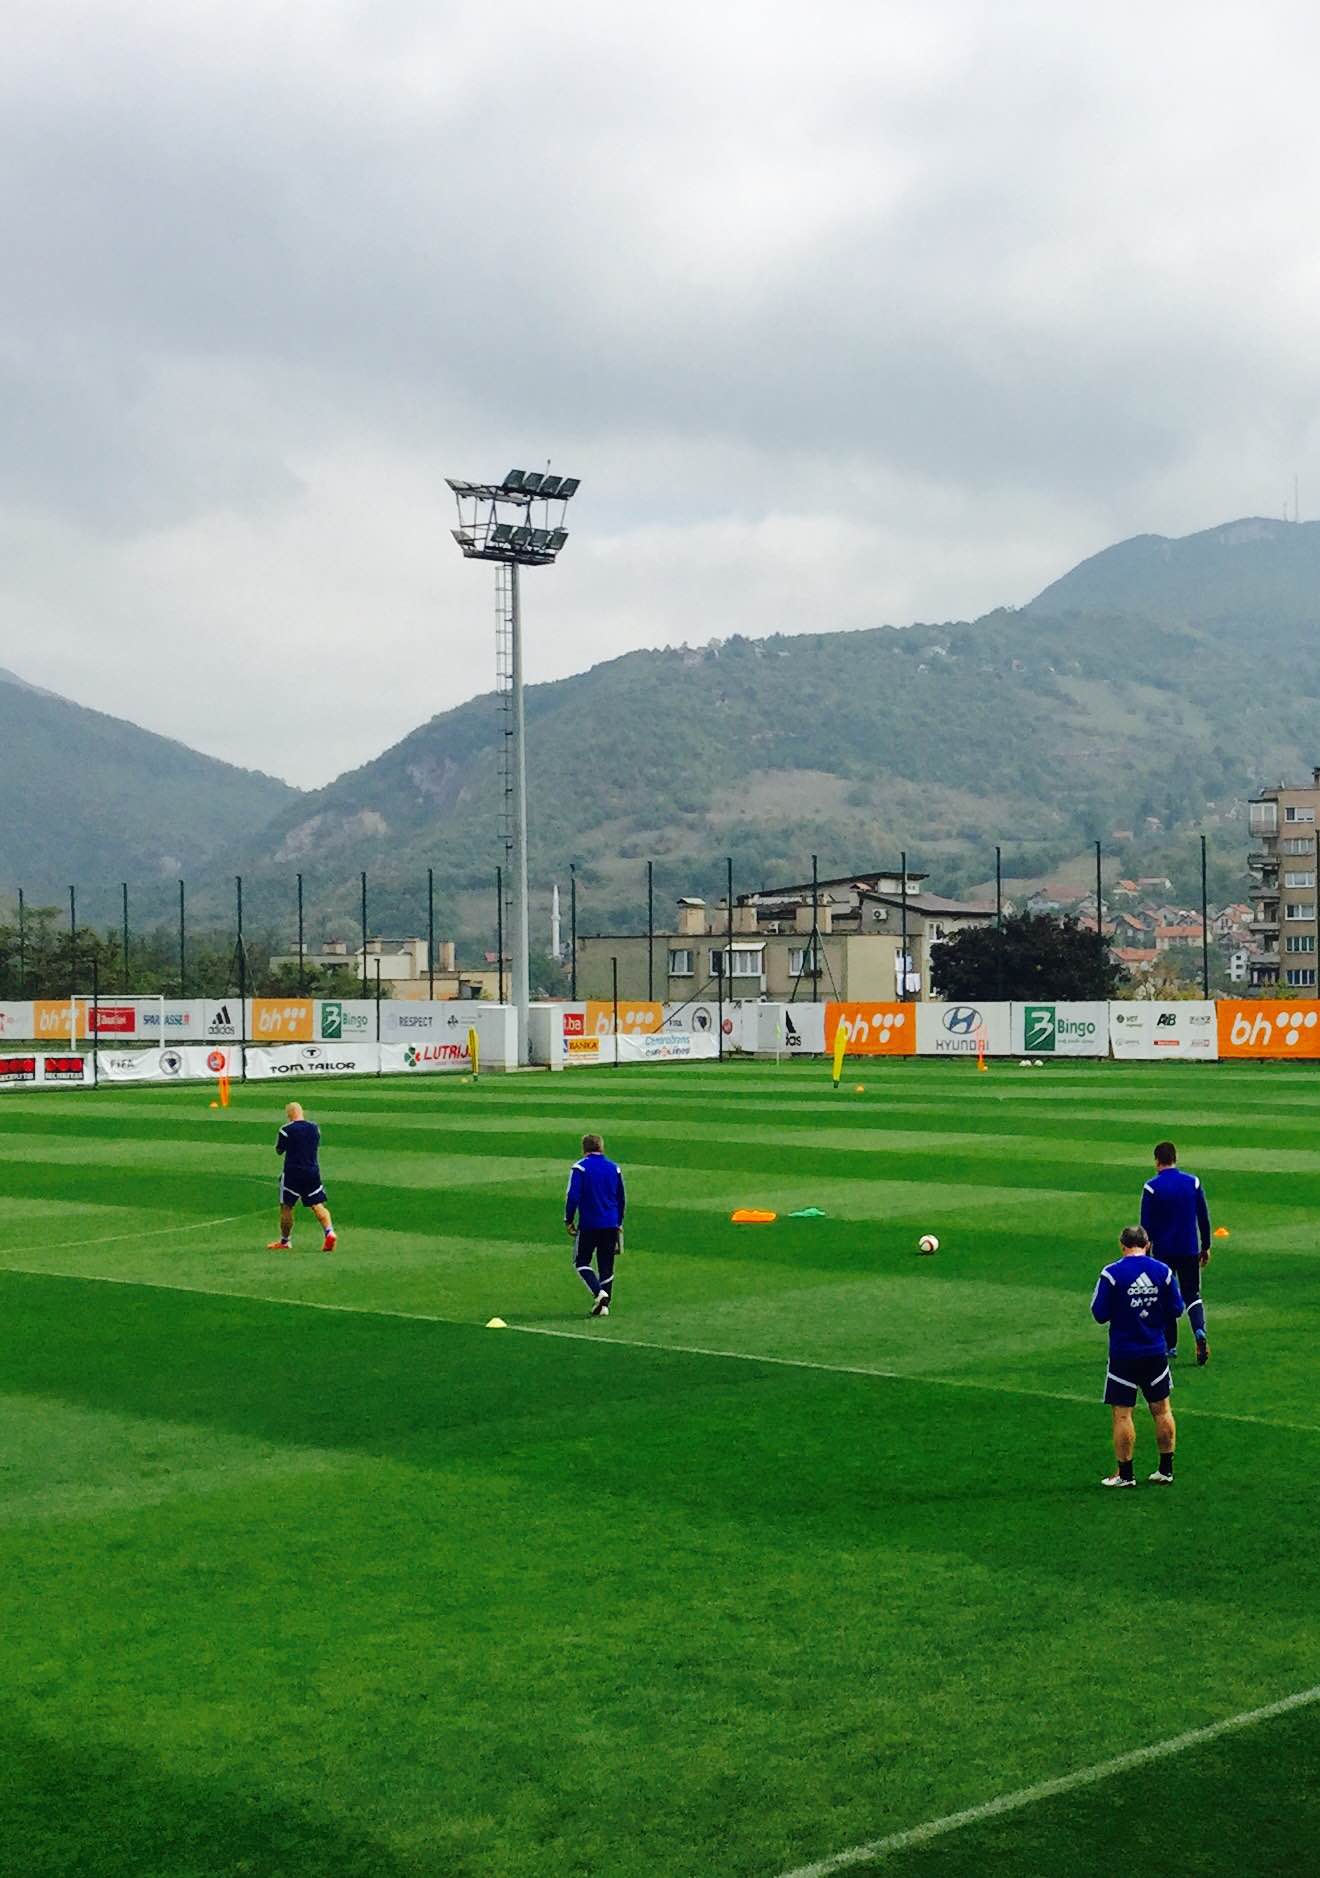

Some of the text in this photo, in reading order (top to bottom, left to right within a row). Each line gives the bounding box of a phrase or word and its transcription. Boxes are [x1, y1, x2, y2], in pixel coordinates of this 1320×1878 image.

[143, 1014, 183, 1025] SPARASSE
[258, 1007, 282, 1032] bh
[342, 1013, 368, 1029] Bingo
[399, 1016, 433, 1027] RESPECT
[207, 1025, 235, 1035] adidas
[1057, 1018, 1096, 1038] Bingo
[1230, 1011, 1273, 1046] bh
[936, 1039, 990, 1051] HYUNDAI
[270, 1061, 356, 1074] TOM TAILOR
[1127, 1286, 1159, 1296] adidas
